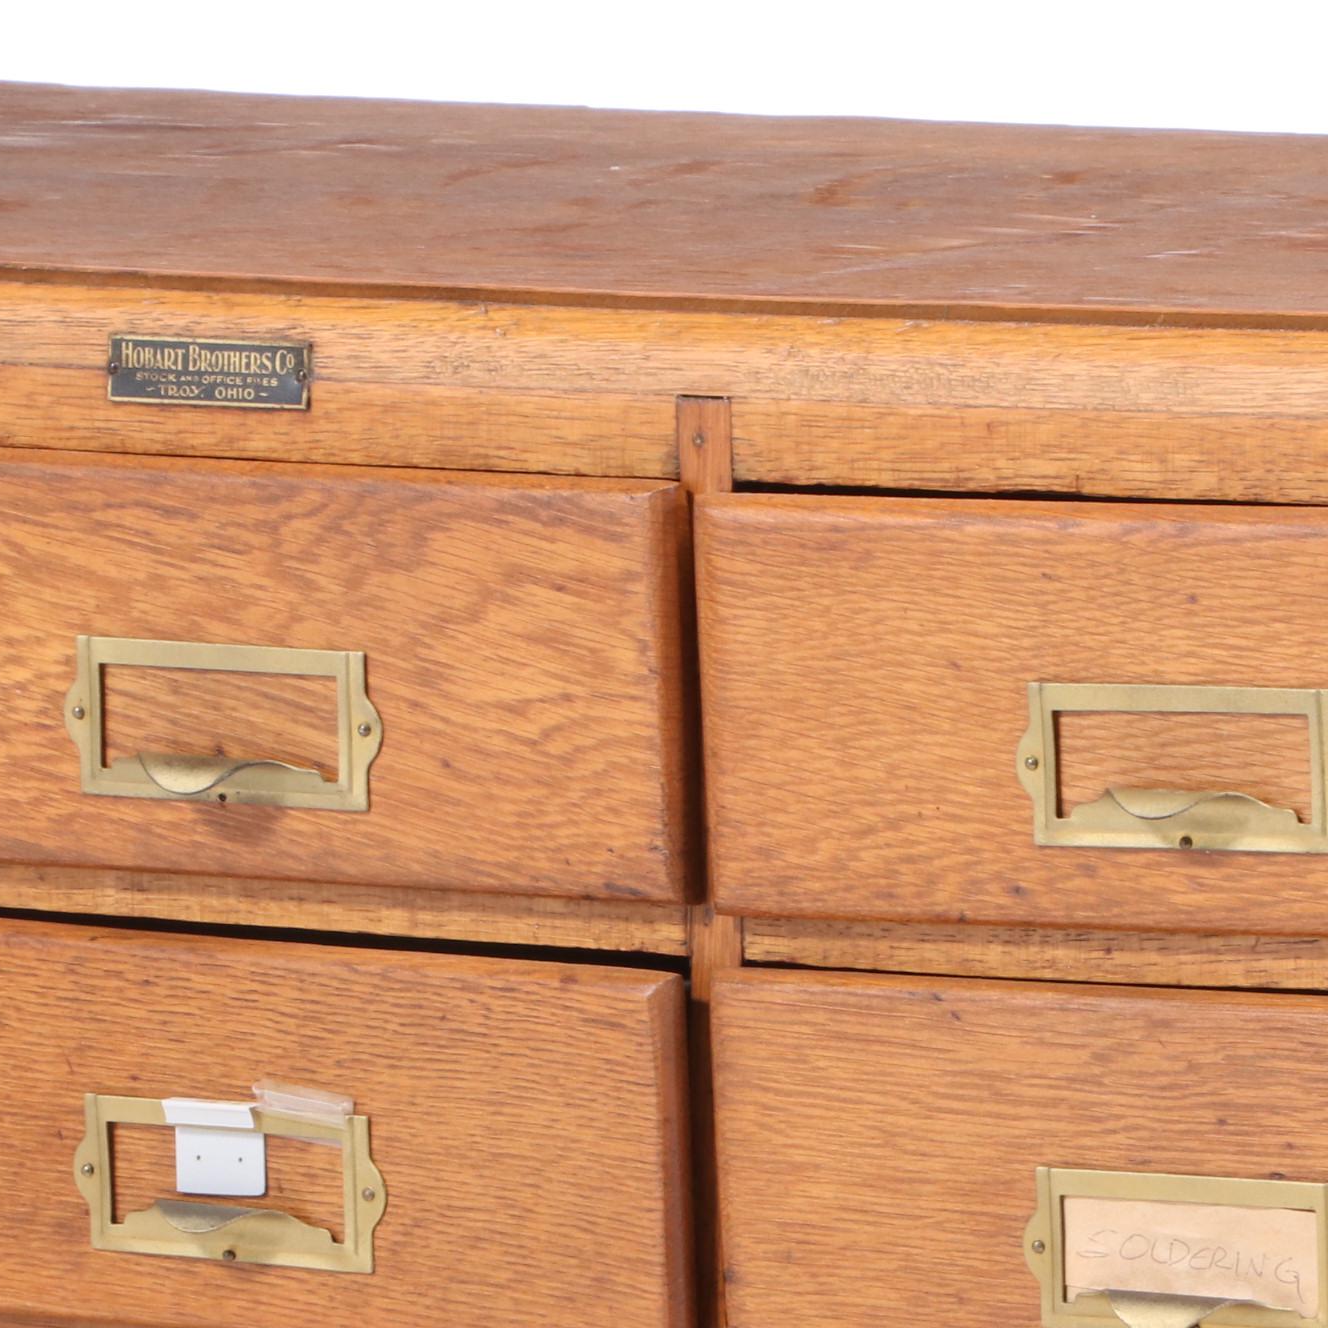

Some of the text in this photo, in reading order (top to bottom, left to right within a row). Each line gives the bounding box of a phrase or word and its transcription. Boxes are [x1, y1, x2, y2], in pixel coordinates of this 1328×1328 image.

[135, 372, 177, 383] STOCK
[201, 375, 243, 386] OFFICE
[214, 387, 255, 400] OHIO
[1076, 1229, 1306, 1304] SOLDERING
